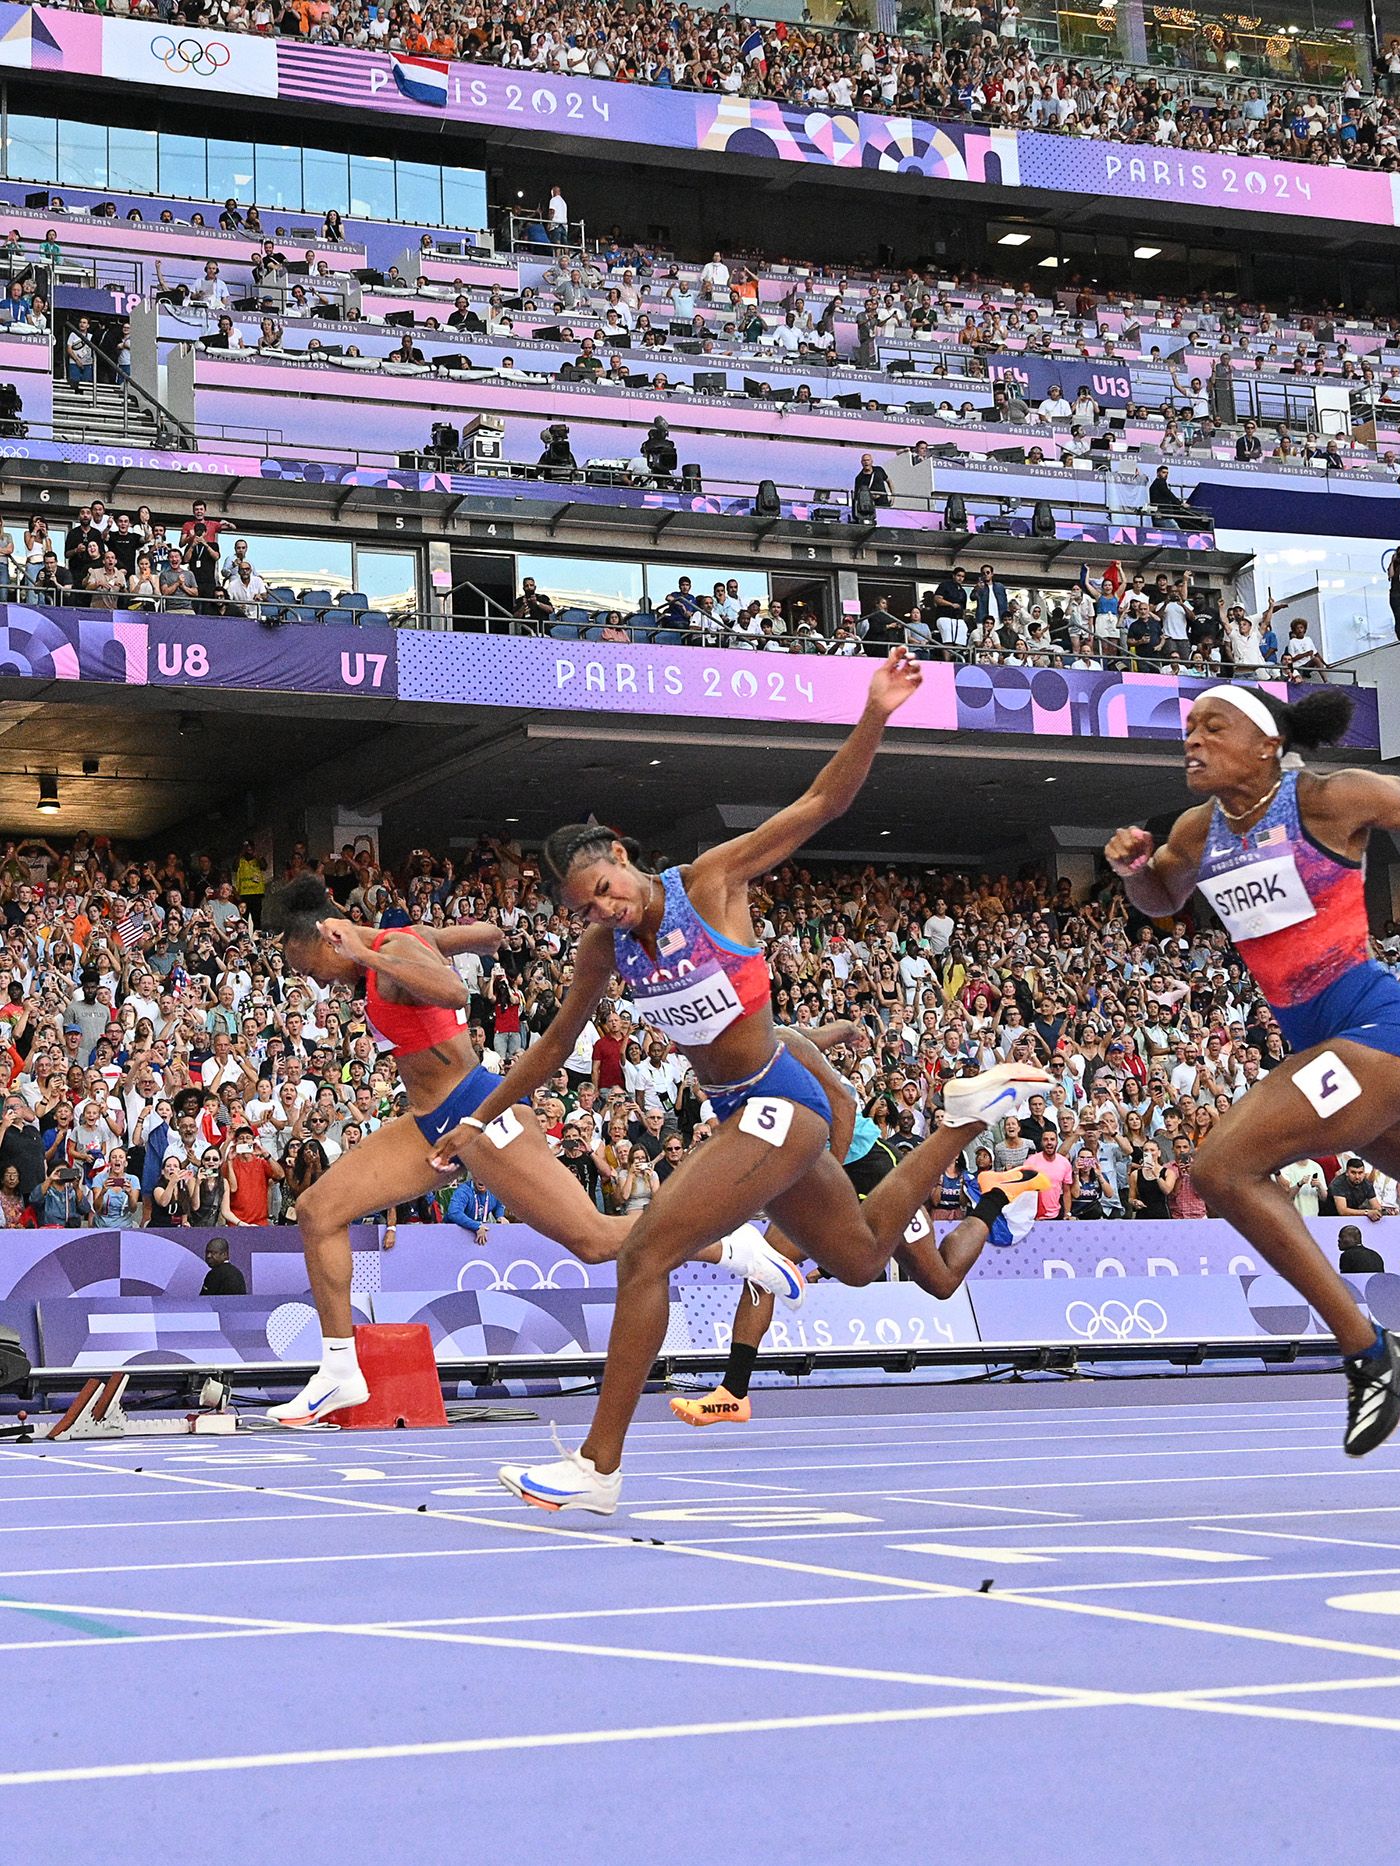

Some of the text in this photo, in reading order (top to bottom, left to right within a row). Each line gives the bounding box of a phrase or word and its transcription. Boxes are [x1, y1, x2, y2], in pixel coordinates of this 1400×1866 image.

[506, 85, 609, 121] 2024
[1222, 168, 1312, 200] 2024
[1092, 375, 1131, 398] U13
[39, 489, 51, 502] 6
[395, 517, 404, 529] 5
[487, 524, 497, 536] 4
[807, 547, 816, 559] 3
[893, 554, 902, 566] 2
[157, 643, 210, 678] U8
[340, 651, 388, 687] U7
[702, 667, 814, 703] 2024
[1215, 874, 1286, 916] STARK
[642, 988, 737, 1026] RUSSELL
[492, 1115, 508, 1134] 7
[757, 1105, 777, 1130] 5
[911, 1217, 922, 1233] 8
[849, 1317, 954, 1344] 2024
[699, 1403, 740, 1414] NITRO
[628, 1506, 885, 1528] 5
